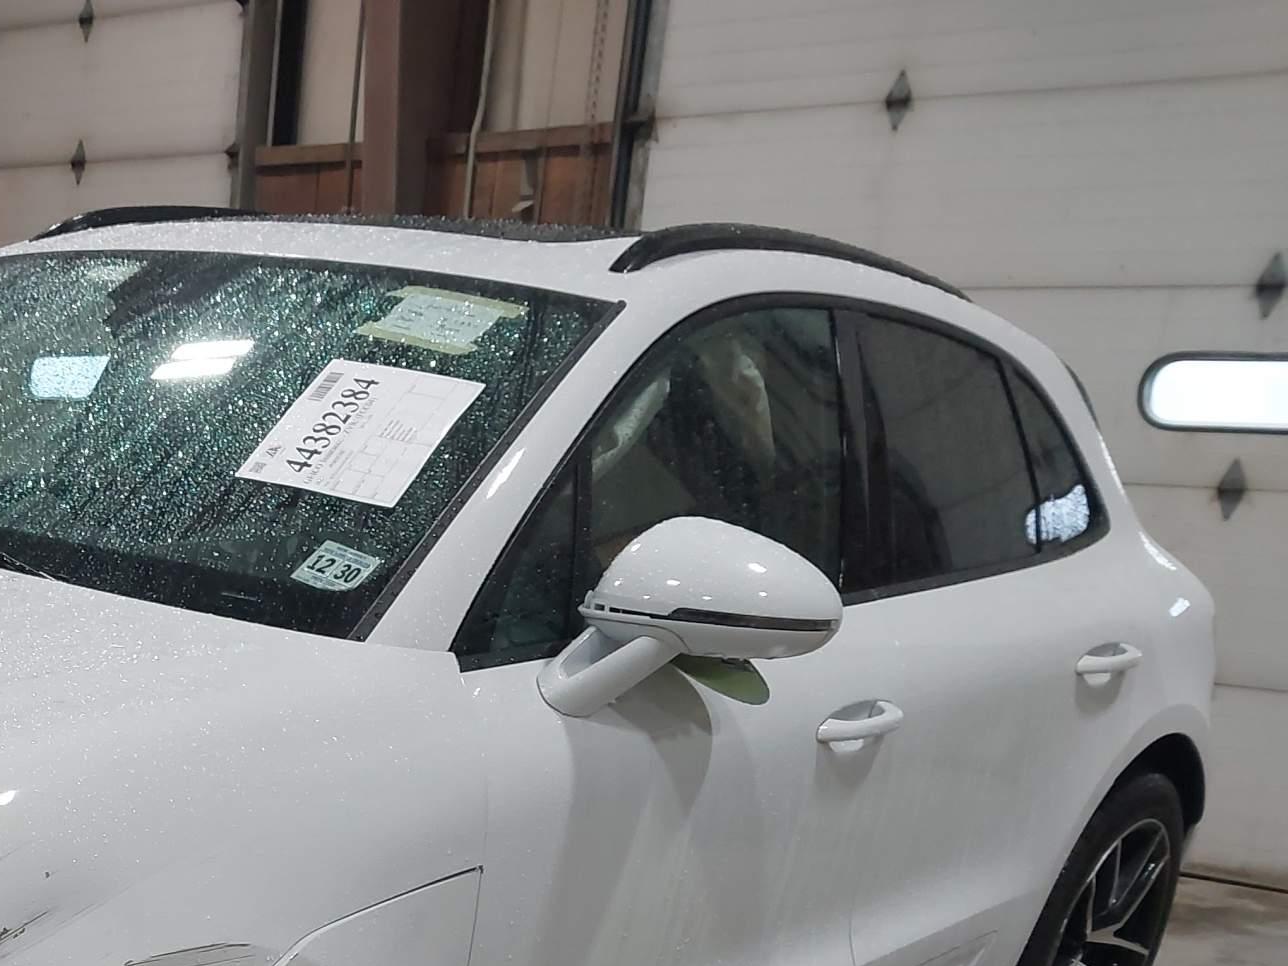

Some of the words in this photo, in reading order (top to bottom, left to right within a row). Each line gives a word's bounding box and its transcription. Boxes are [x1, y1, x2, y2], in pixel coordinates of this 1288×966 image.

[285, 376, 381, 474] 44382384
[307, 554, 337, 575] 12
[333, 563, 362, 584] 30
